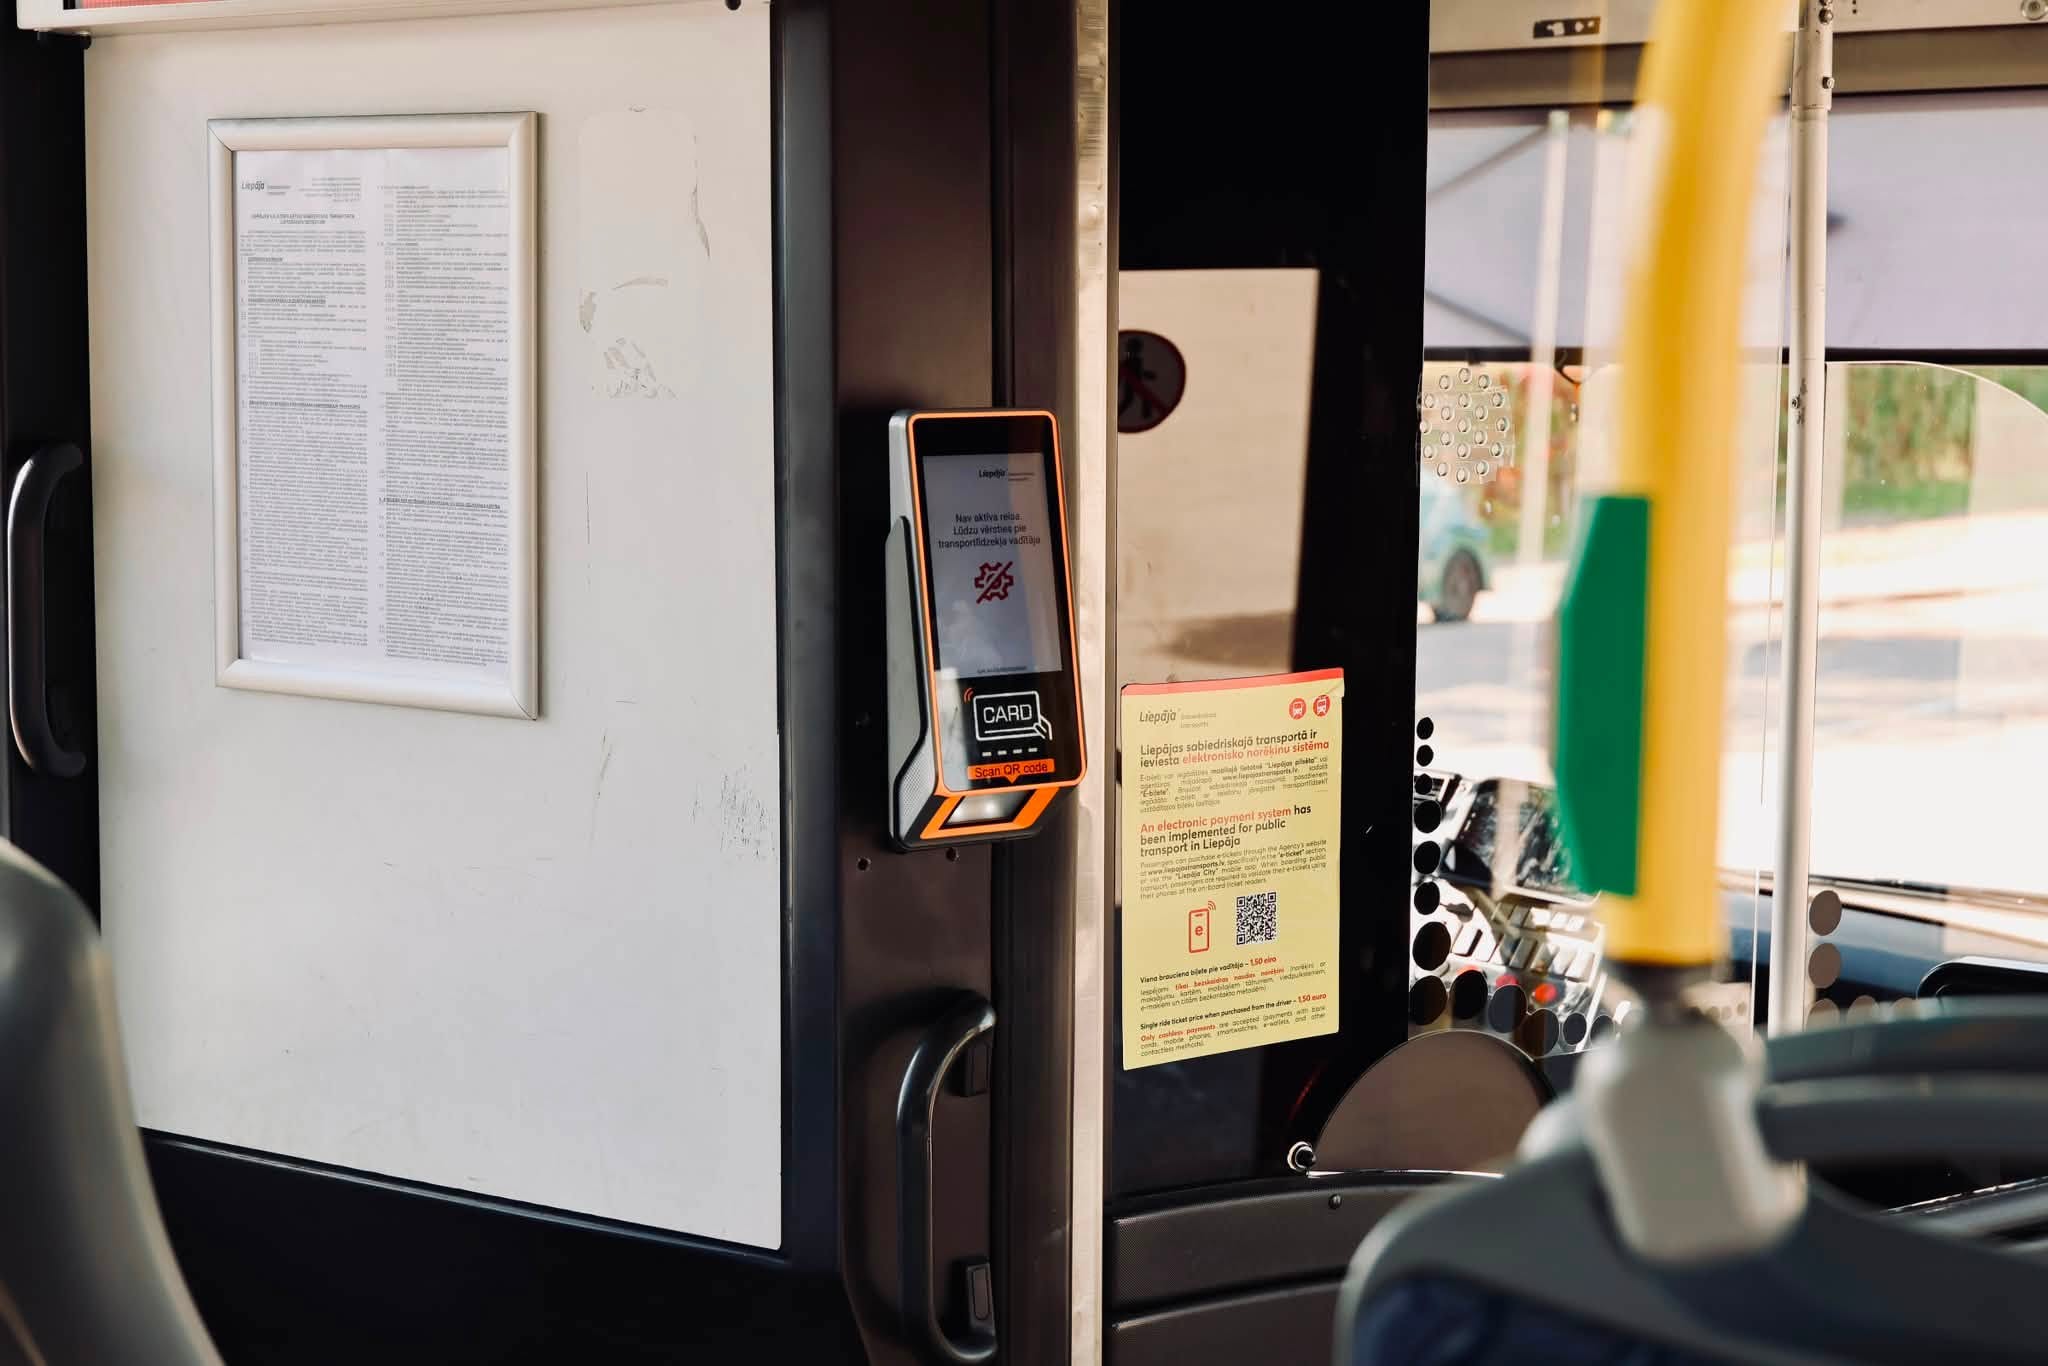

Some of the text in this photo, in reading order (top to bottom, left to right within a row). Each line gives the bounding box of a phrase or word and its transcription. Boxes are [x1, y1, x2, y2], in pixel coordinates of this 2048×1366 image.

[955, 513, 973, 523] Nav
[974, 512, 998, 522] aktīva
[953, 523, 1027, 535] Lūdzu vērsties pie
[982, 704, 1033, 723] CARD
[1139, 709, 1177, 725] Liepāja
[1140, 729, 1318, 758] Liepājas sabiedriskajā transportā ir
[1140, 741, 1329, 768] ieviesta elektronisko norēķinu sistēma
[975, 762, 1048, 778] Scan QR code
[1140, 805, 1312, 833] An electronic payment system has
[1140, 819, 1286, 845] been implemented for public
[1140, 836, 1241, 857] transport in Liepāja
[1278, 848, 1305, 858] "e-ticket"
[1306, 839, 1327, 847] website
[1175, 870, 1201, 881] "Liepāja
[1203, 868, 1219, 877] City"
[1260, 860, 1278, 868] When
[1280, 857, 1307, 867] boarding
[1309, 853, 1327, 863] public
[1194, 924, 1204, 936] e
[1140, 976, 1158, 984] Viena
[1158, 970, 1190, 981] brauciena
[1208, 965, 1218, 975] pie
[1219, 960, 1244, 971] vadītāja
[1264, 955, 1277, 965] eiro
[1193, 976, 1229, 988] bezskaidras
[1233, 972, 1256, 981] naudas
[1140, 1021, 1158, 1031] Single
[1159, 1019, 1171, 1027] ride
[1171, 1016, 1188, 1025] ticket
[1188, 1013, 1204, 1023] price
[1204, 1011, 1220, 1019] when
[1220, 1004, 1251, 1017] purchased
[1251, 1003, 1265, 1011] from
[1265, 1001, 1275, 1009] the
[1275, 998, 1292, 1007] driver
[1311, 993, 1327, 1001] euro
[1140, 1033, 1155, 1042] Only
[1158, 1028, 1184, 1039] cashless
[1186, 1024, 1216, 1036] payments
[1232, 1016, 1260, 1027] accepted
[1262, 1010, 1293, 1022] (payments
[1296, 1007, 1309, 1015] with
[1163, 1036, 1185, 1046] mobile
[1294, 1015, 1307, 1023] and
[1310, 1012, 1326, 1020] other
[1140, 1045, 1175, 1057] contactless
